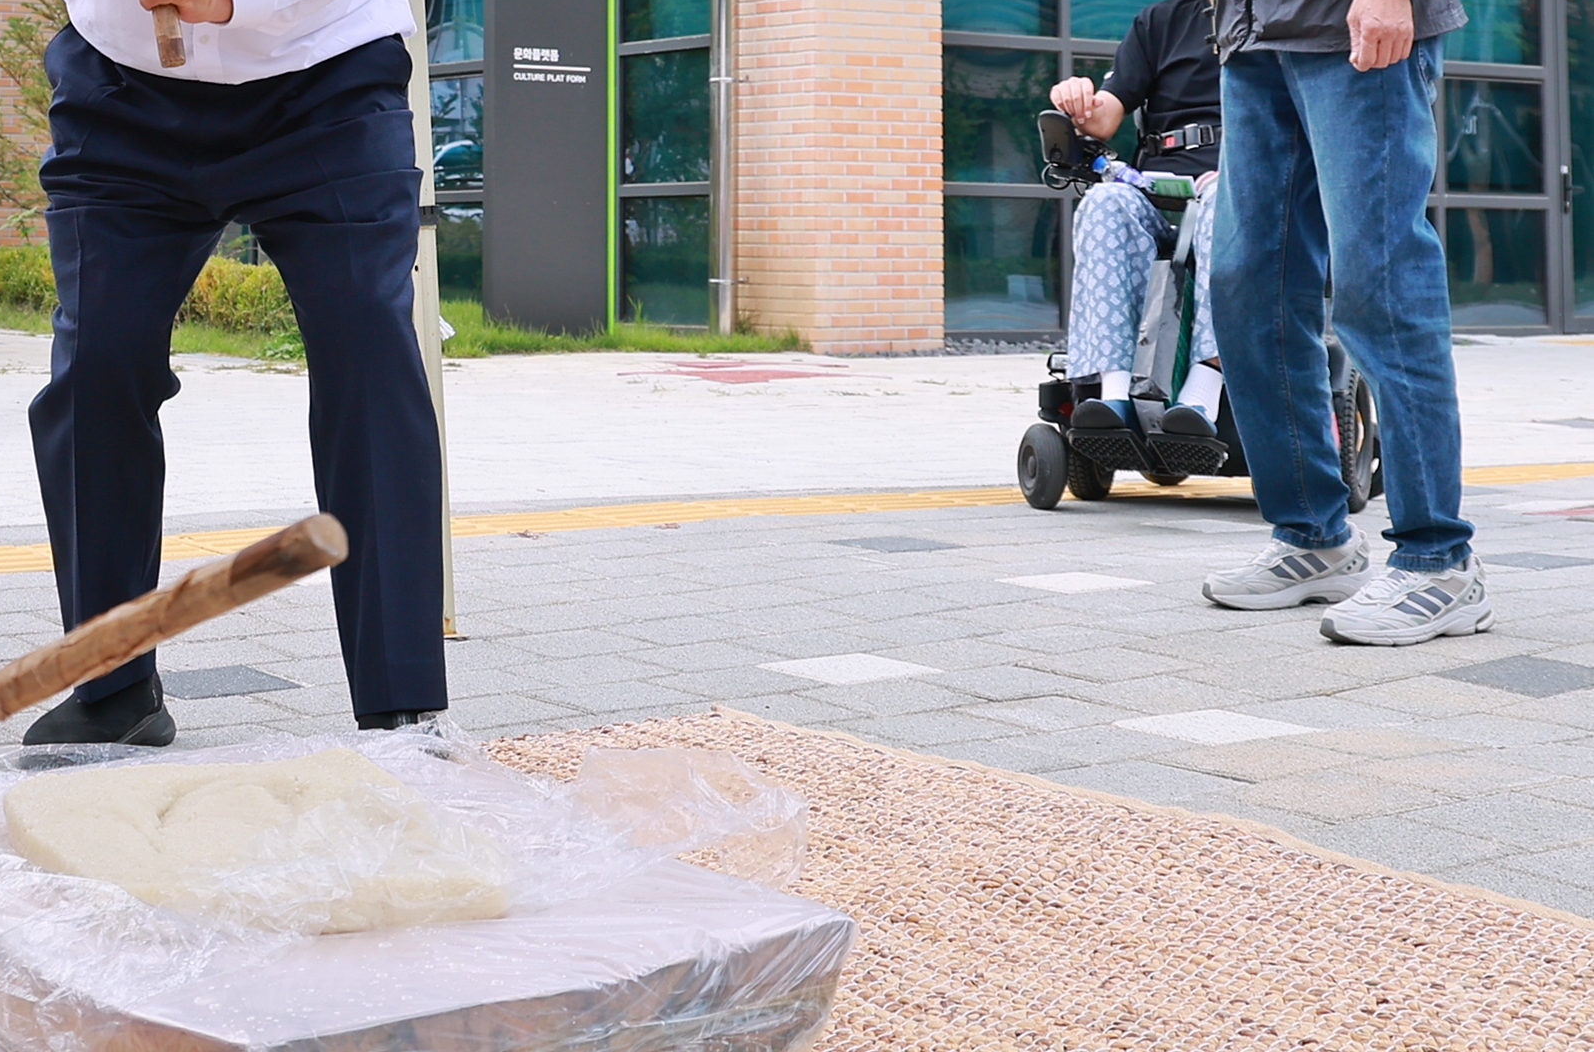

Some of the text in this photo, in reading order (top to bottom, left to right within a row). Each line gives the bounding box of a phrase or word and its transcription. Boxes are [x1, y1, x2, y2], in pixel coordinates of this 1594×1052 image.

[513, 47, 560, 62] 문화플랫폼
[513, 72, 587, 84] CULTURE PLAT FORM
